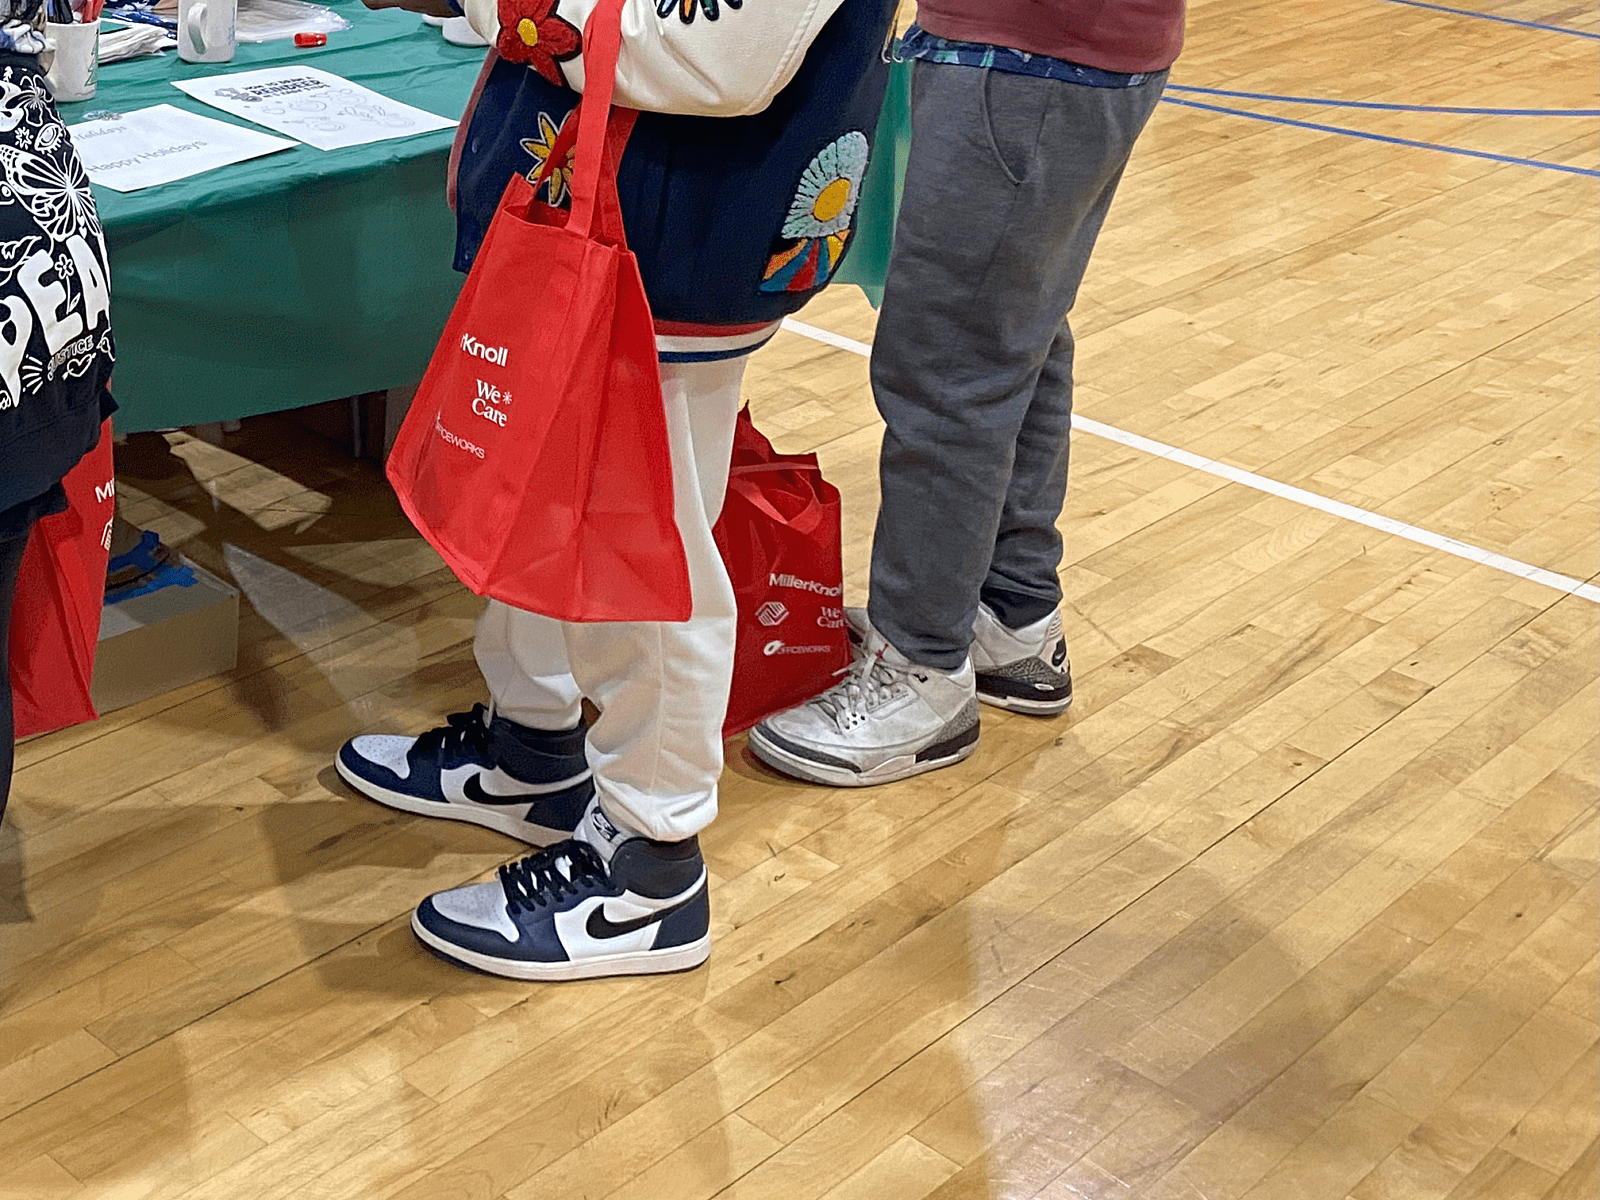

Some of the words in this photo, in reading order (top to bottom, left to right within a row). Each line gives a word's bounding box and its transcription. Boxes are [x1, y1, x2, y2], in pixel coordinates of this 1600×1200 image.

[84, 158, 141, 173] Happy
[137, 140, 207, 160] Holidays
[476, 378, 502, 405] We
[472, 398, 508, 428] Care
